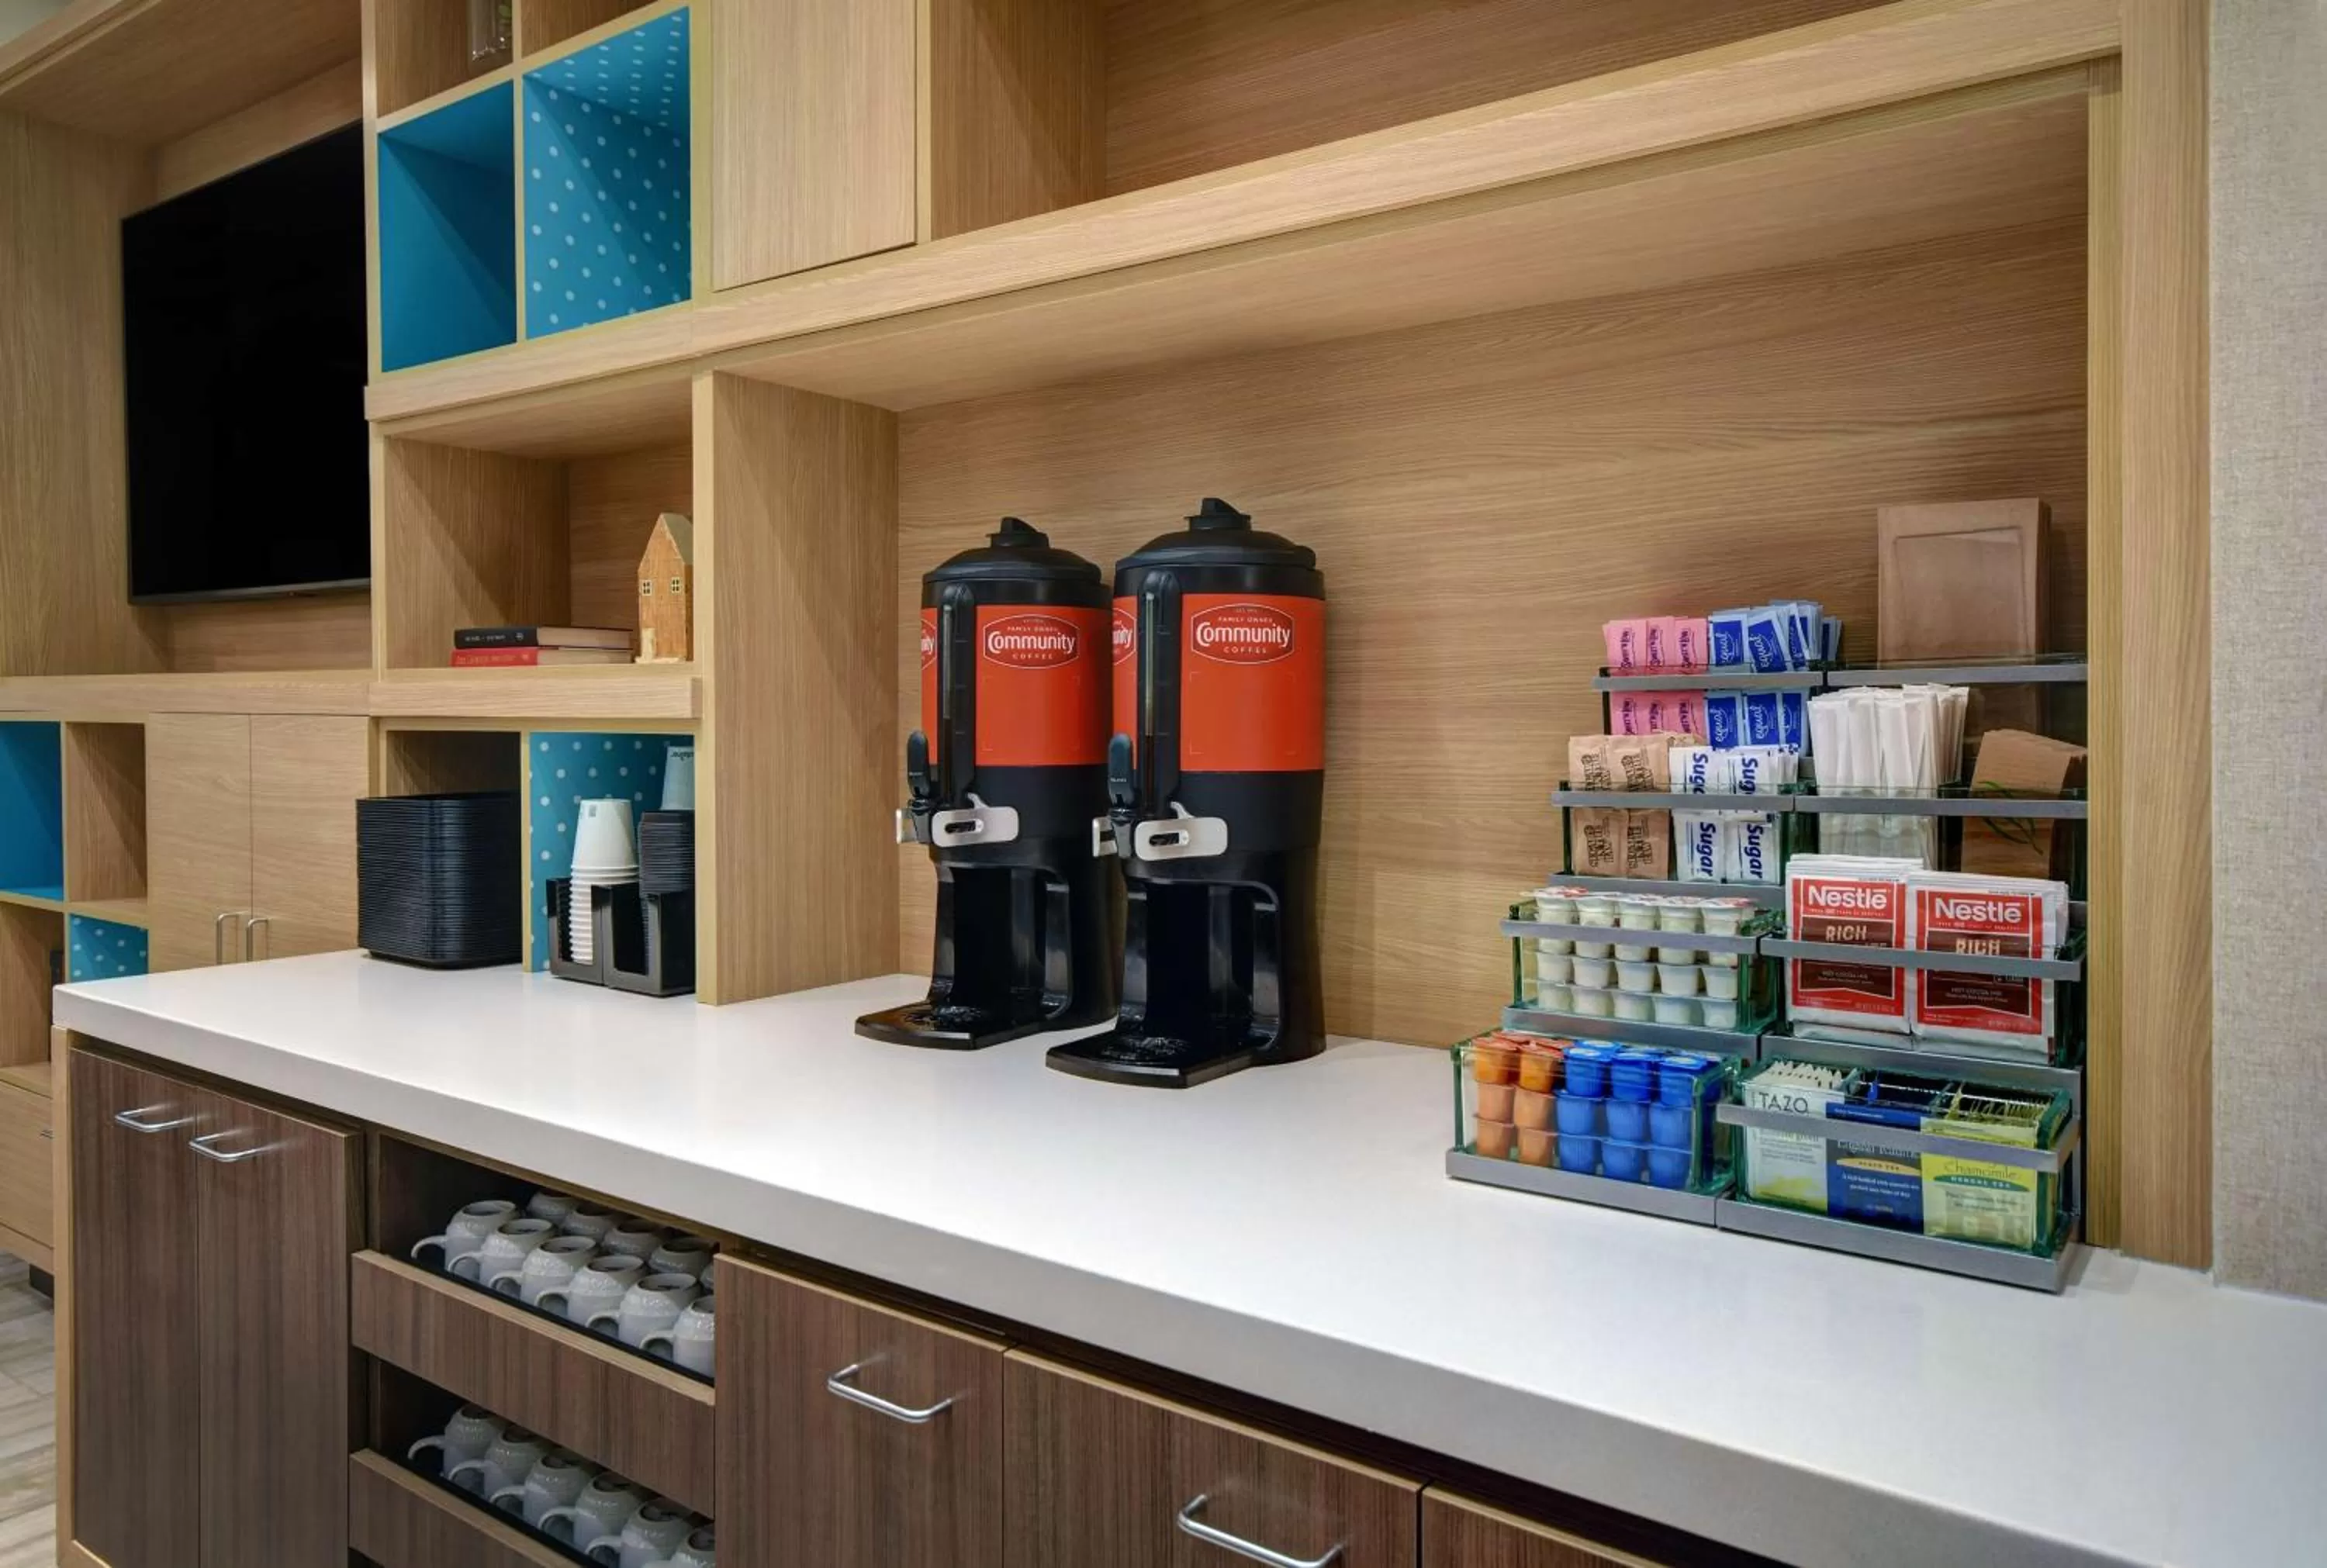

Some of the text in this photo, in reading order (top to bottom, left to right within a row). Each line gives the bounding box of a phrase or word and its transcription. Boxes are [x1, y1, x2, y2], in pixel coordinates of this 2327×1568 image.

[988, 630, 1075, 654] Community
[1196, 621, 1291, 648] Community
[1710, 708, 1728, 742] equal
[1749, 705, 1769, 739] equal
[1739, 758, 1758, 794] Sug
[1696, 821, 1716, 876] Sugar
[1744, 824, 1764, 879] Sugar
[1825, 925, 1868, 942] RICH
[1955, 938, 2000, 956] RICH
[1758, 1091, 1809, 1114] TAZO
